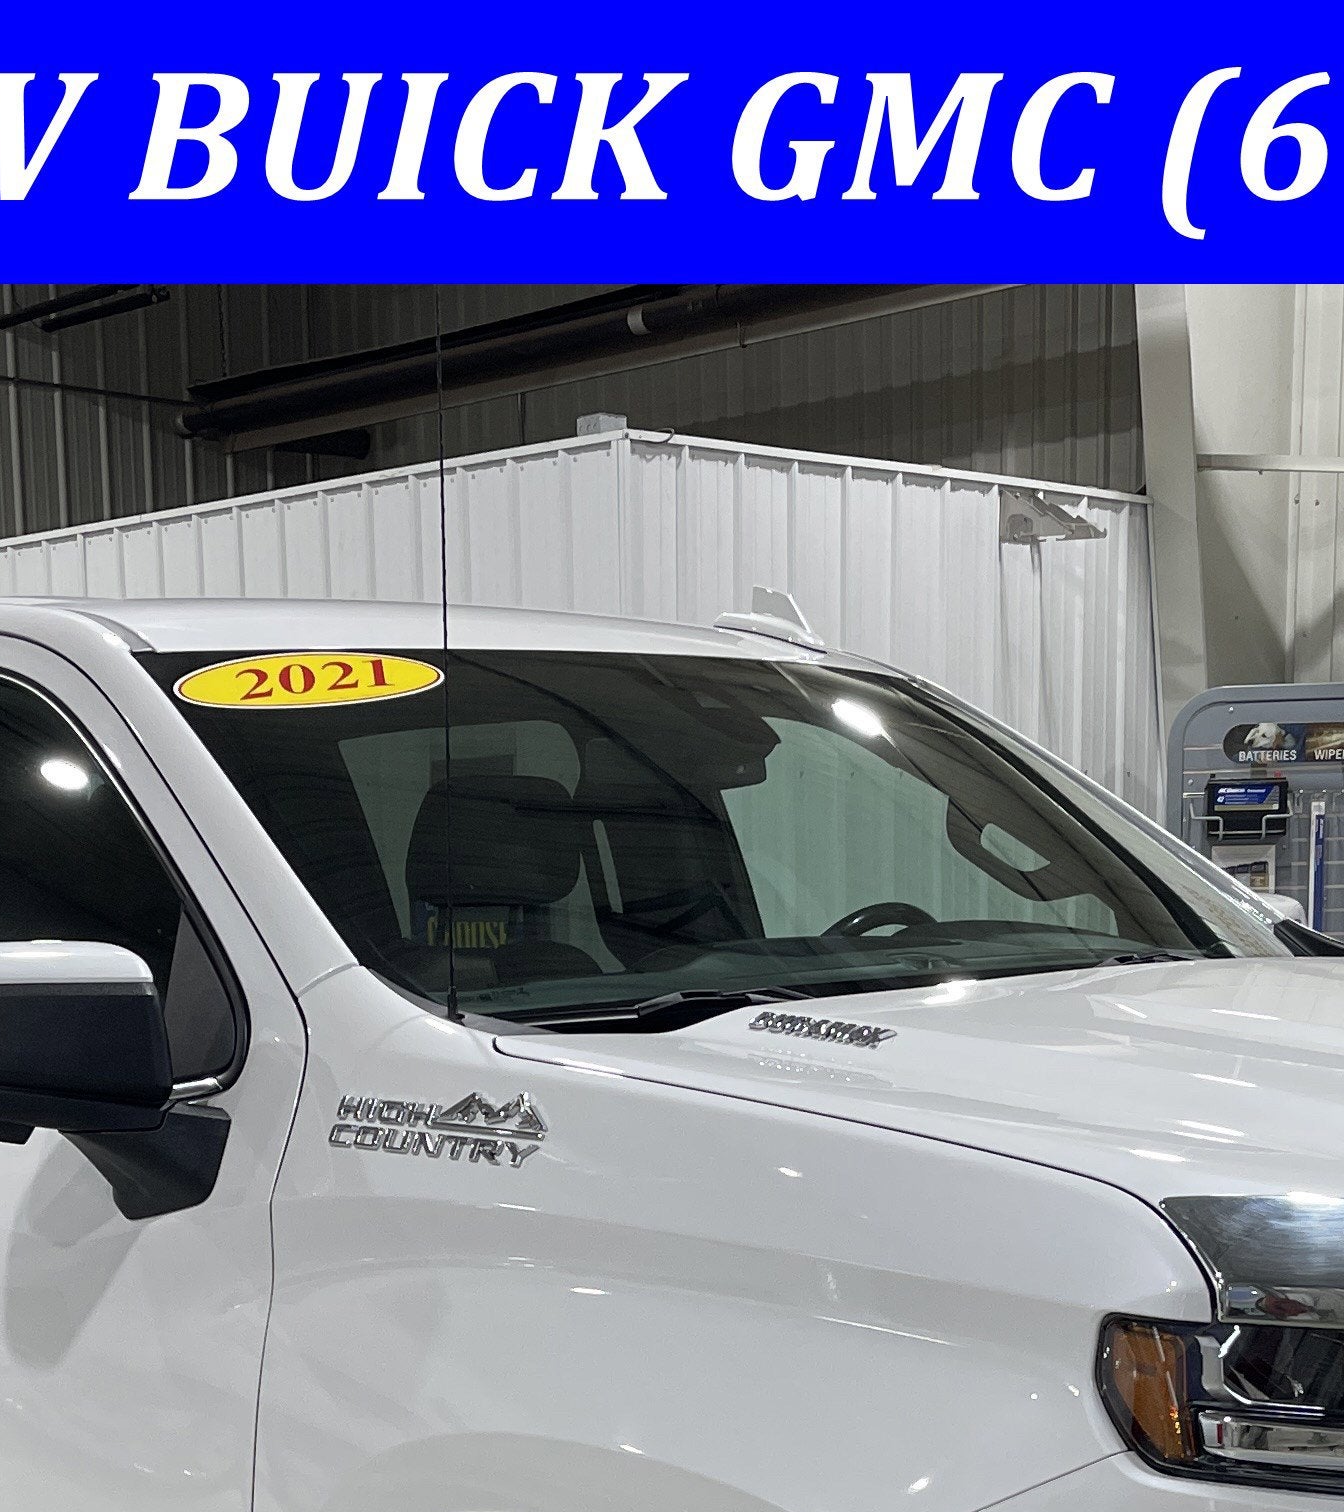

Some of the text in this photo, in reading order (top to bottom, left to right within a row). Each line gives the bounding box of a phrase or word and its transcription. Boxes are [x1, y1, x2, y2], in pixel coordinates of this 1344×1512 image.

[235, 658, 395, 701] 2021
[1238, 749, 1297, 762] BATTERIES
[337, 1094, 444, 1126] HIGH
[328, 1124, 541, 1168] COUNTRY
